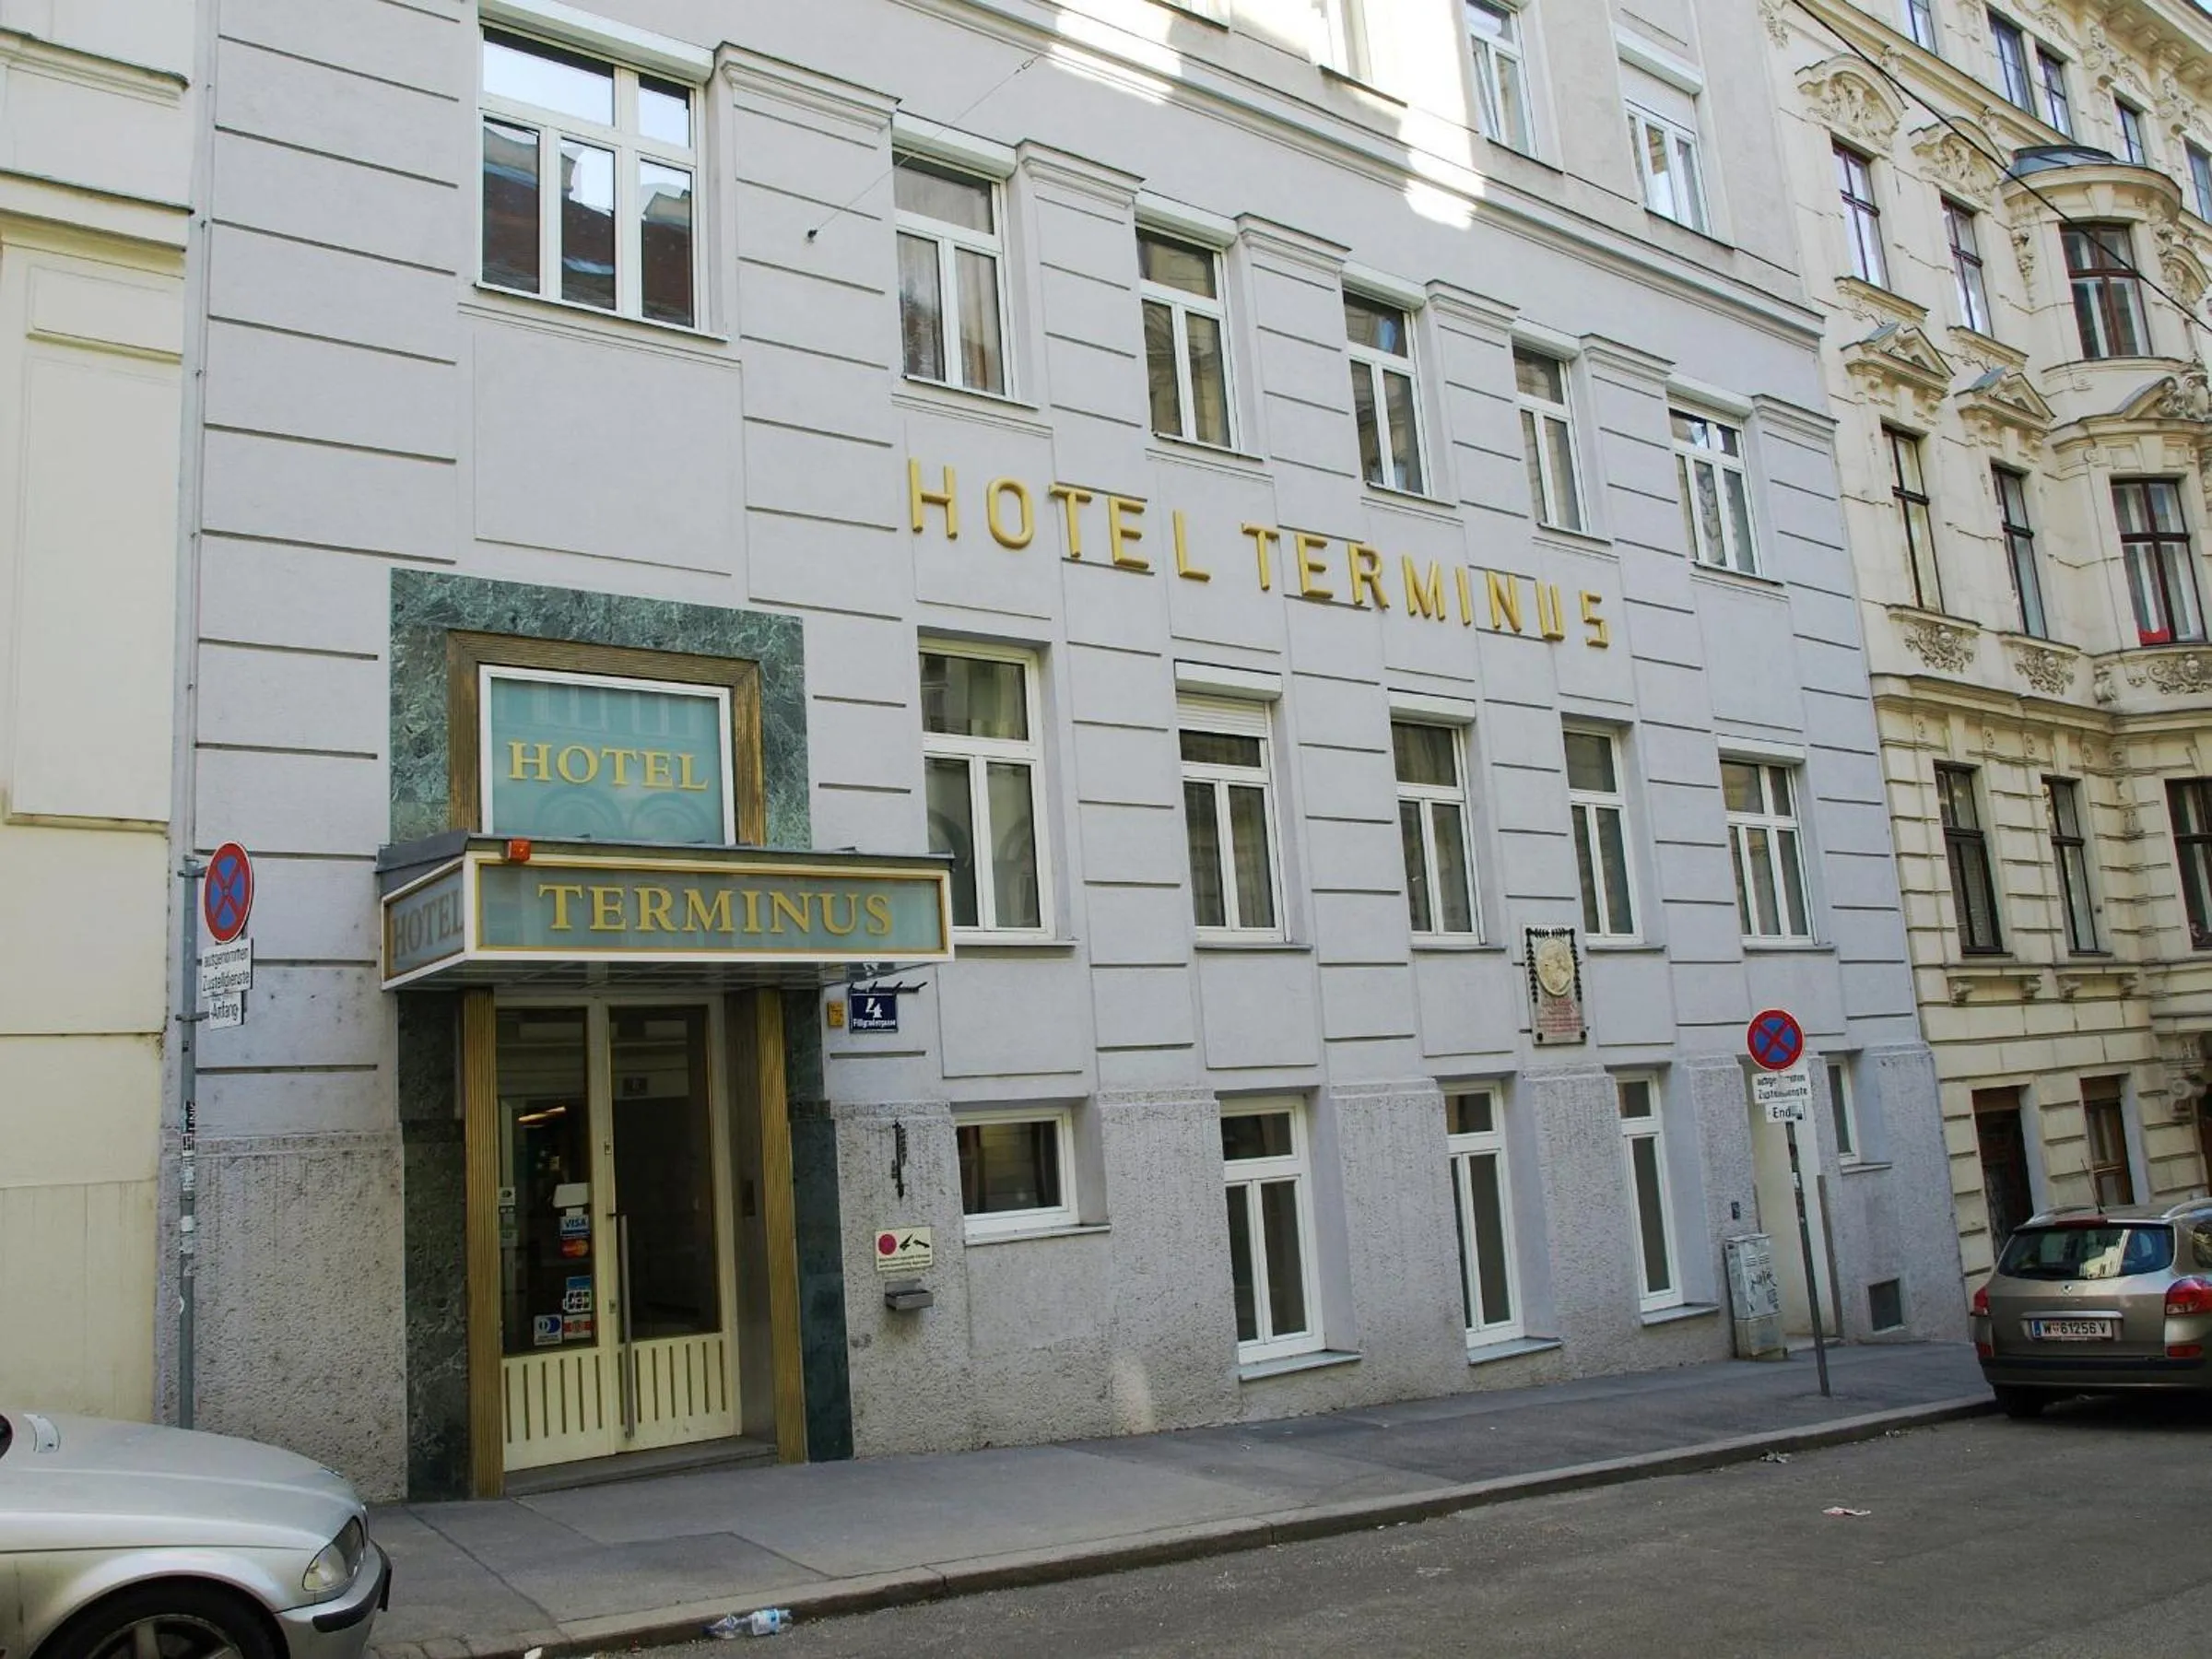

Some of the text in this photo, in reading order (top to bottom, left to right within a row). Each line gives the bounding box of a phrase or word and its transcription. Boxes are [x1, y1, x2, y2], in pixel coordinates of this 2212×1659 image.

[908, 458, 1609, 648] HOTEL TERMINUS
[507, 741, 709, 792] HOTEL
[538, 883, 894, 935] TERMINUS
[393, 888, 464, 959] HOTEL
[211, 1001, 239, 1021] Anfang
[865, 997, 883, 1018] 4
[1771, 1106, 1794, 1119] End
[565, 1218, 587, 1229] VISA
[2041, 1322, 2107, 1335] W 61256 V
